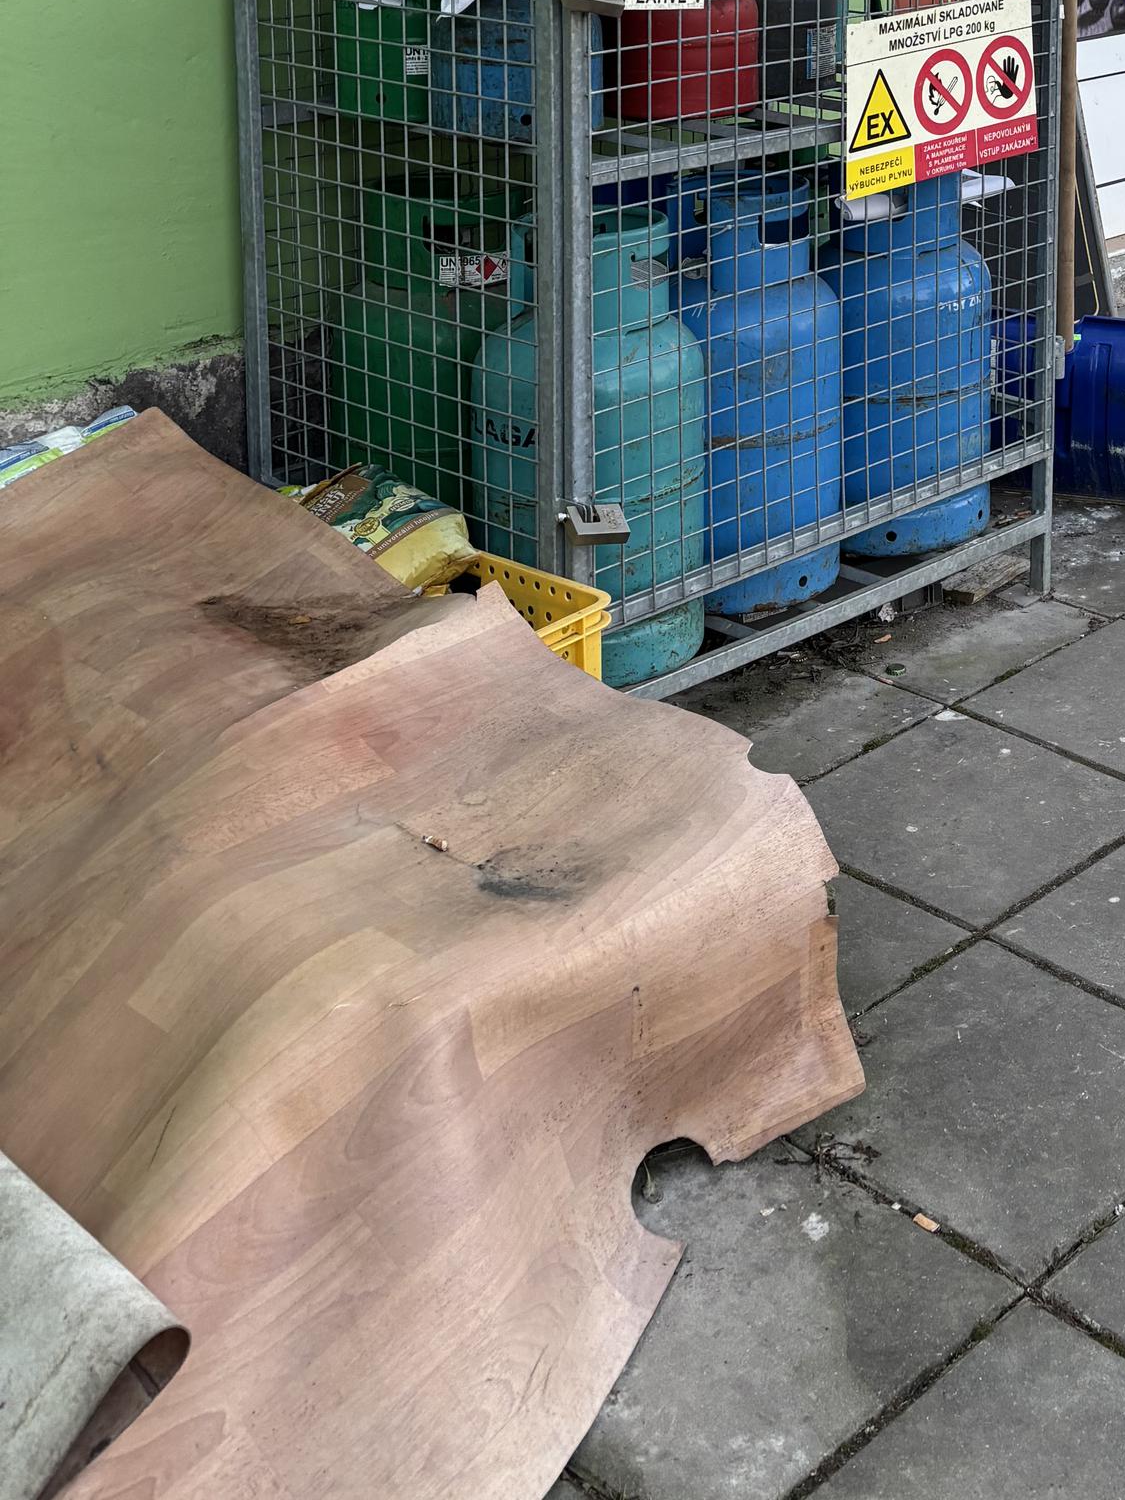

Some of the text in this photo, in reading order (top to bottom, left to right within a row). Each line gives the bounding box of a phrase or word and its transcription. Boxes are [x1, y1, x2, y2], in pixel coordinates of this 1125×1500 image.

[878, 10, 937, 36] MAXIMÁLNÍ
[888, 20, 995, 52] MNOŽSTVÍ LPG 200 kg
[867, 109, 895, 141] EX
[983, 122, 1031, 143] NEPOVOLANÝM
[923, 135, 968, 153] ZÁKAZ KOUŘENÍ
[931, 143, 967, 159] MANIPULACE
[979, 147, 999, 158] VSTUP
[859, 155, 903, 177] NEBEZPEČÍ
[933, 152, 964, 166] PLAMENEM
[849, 167, 913, 192] VÝBUCHU PLYNU
